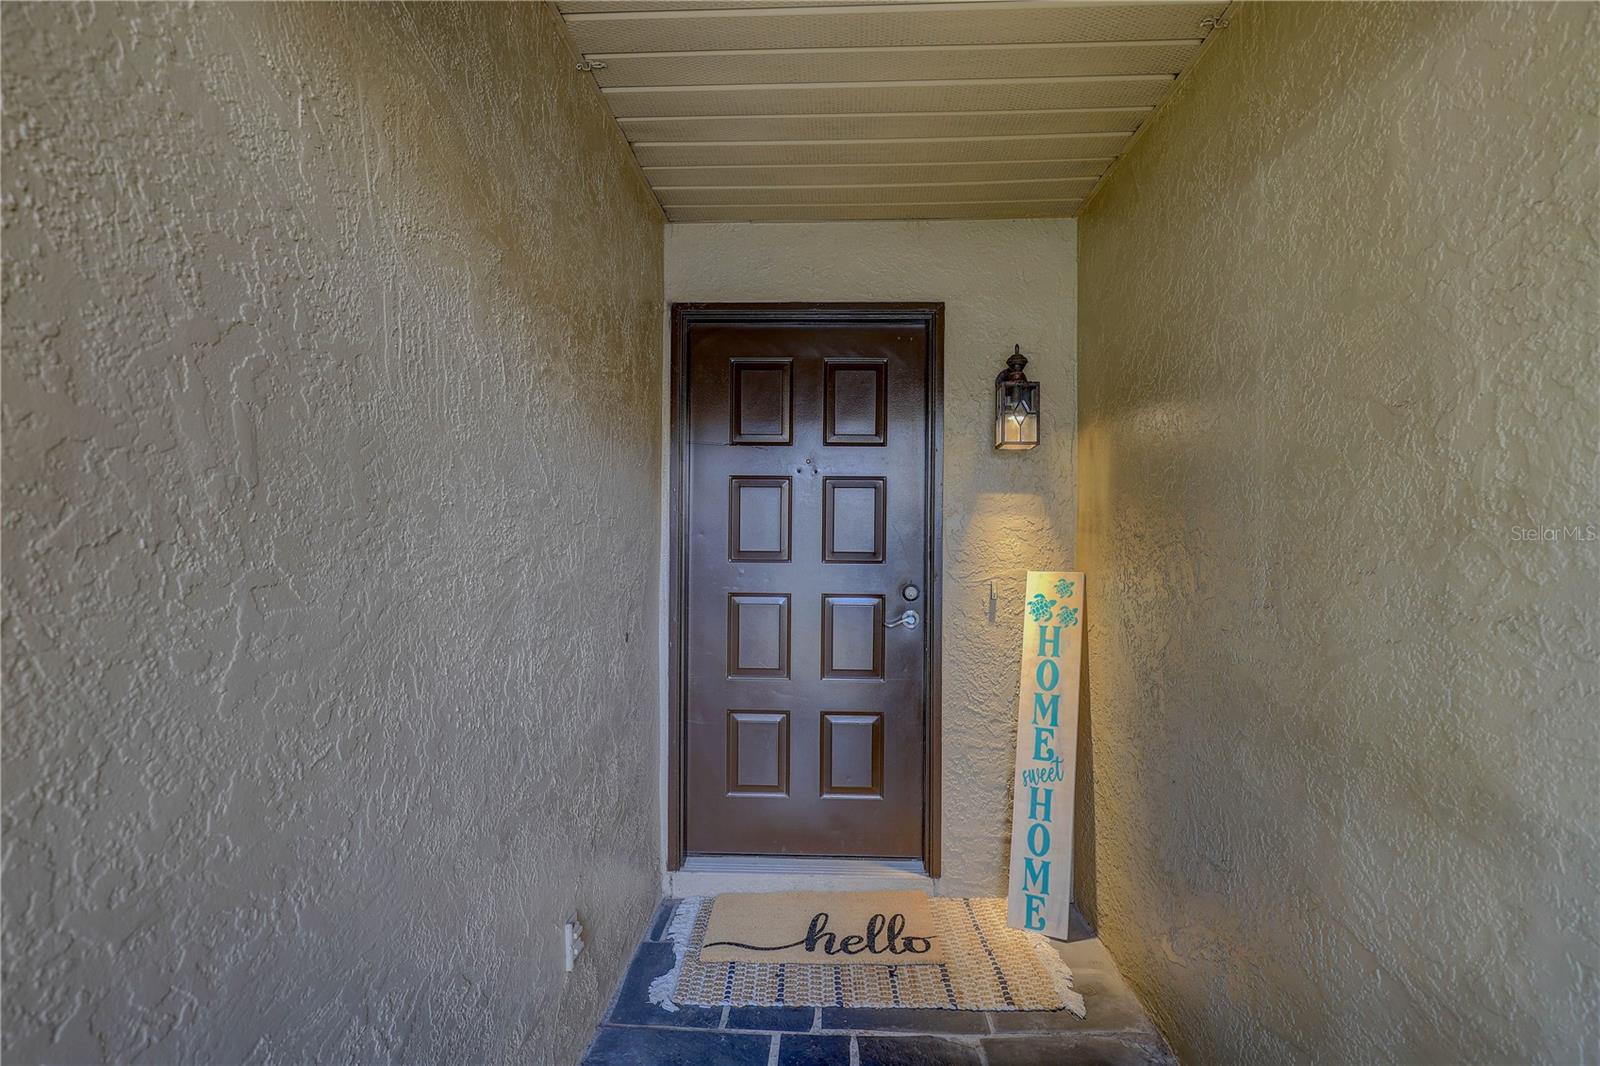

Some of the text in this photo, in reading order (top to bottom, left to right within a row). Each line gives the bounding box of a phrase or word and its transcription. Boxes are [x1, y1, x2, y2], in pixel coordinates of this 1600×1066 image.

[1031, 625, 1060, 763] HOME
[1022, 757, 1064, 787] sweet
[1022, 786, 1052, 931] HOME
[703, 912, 938, 956] hello
